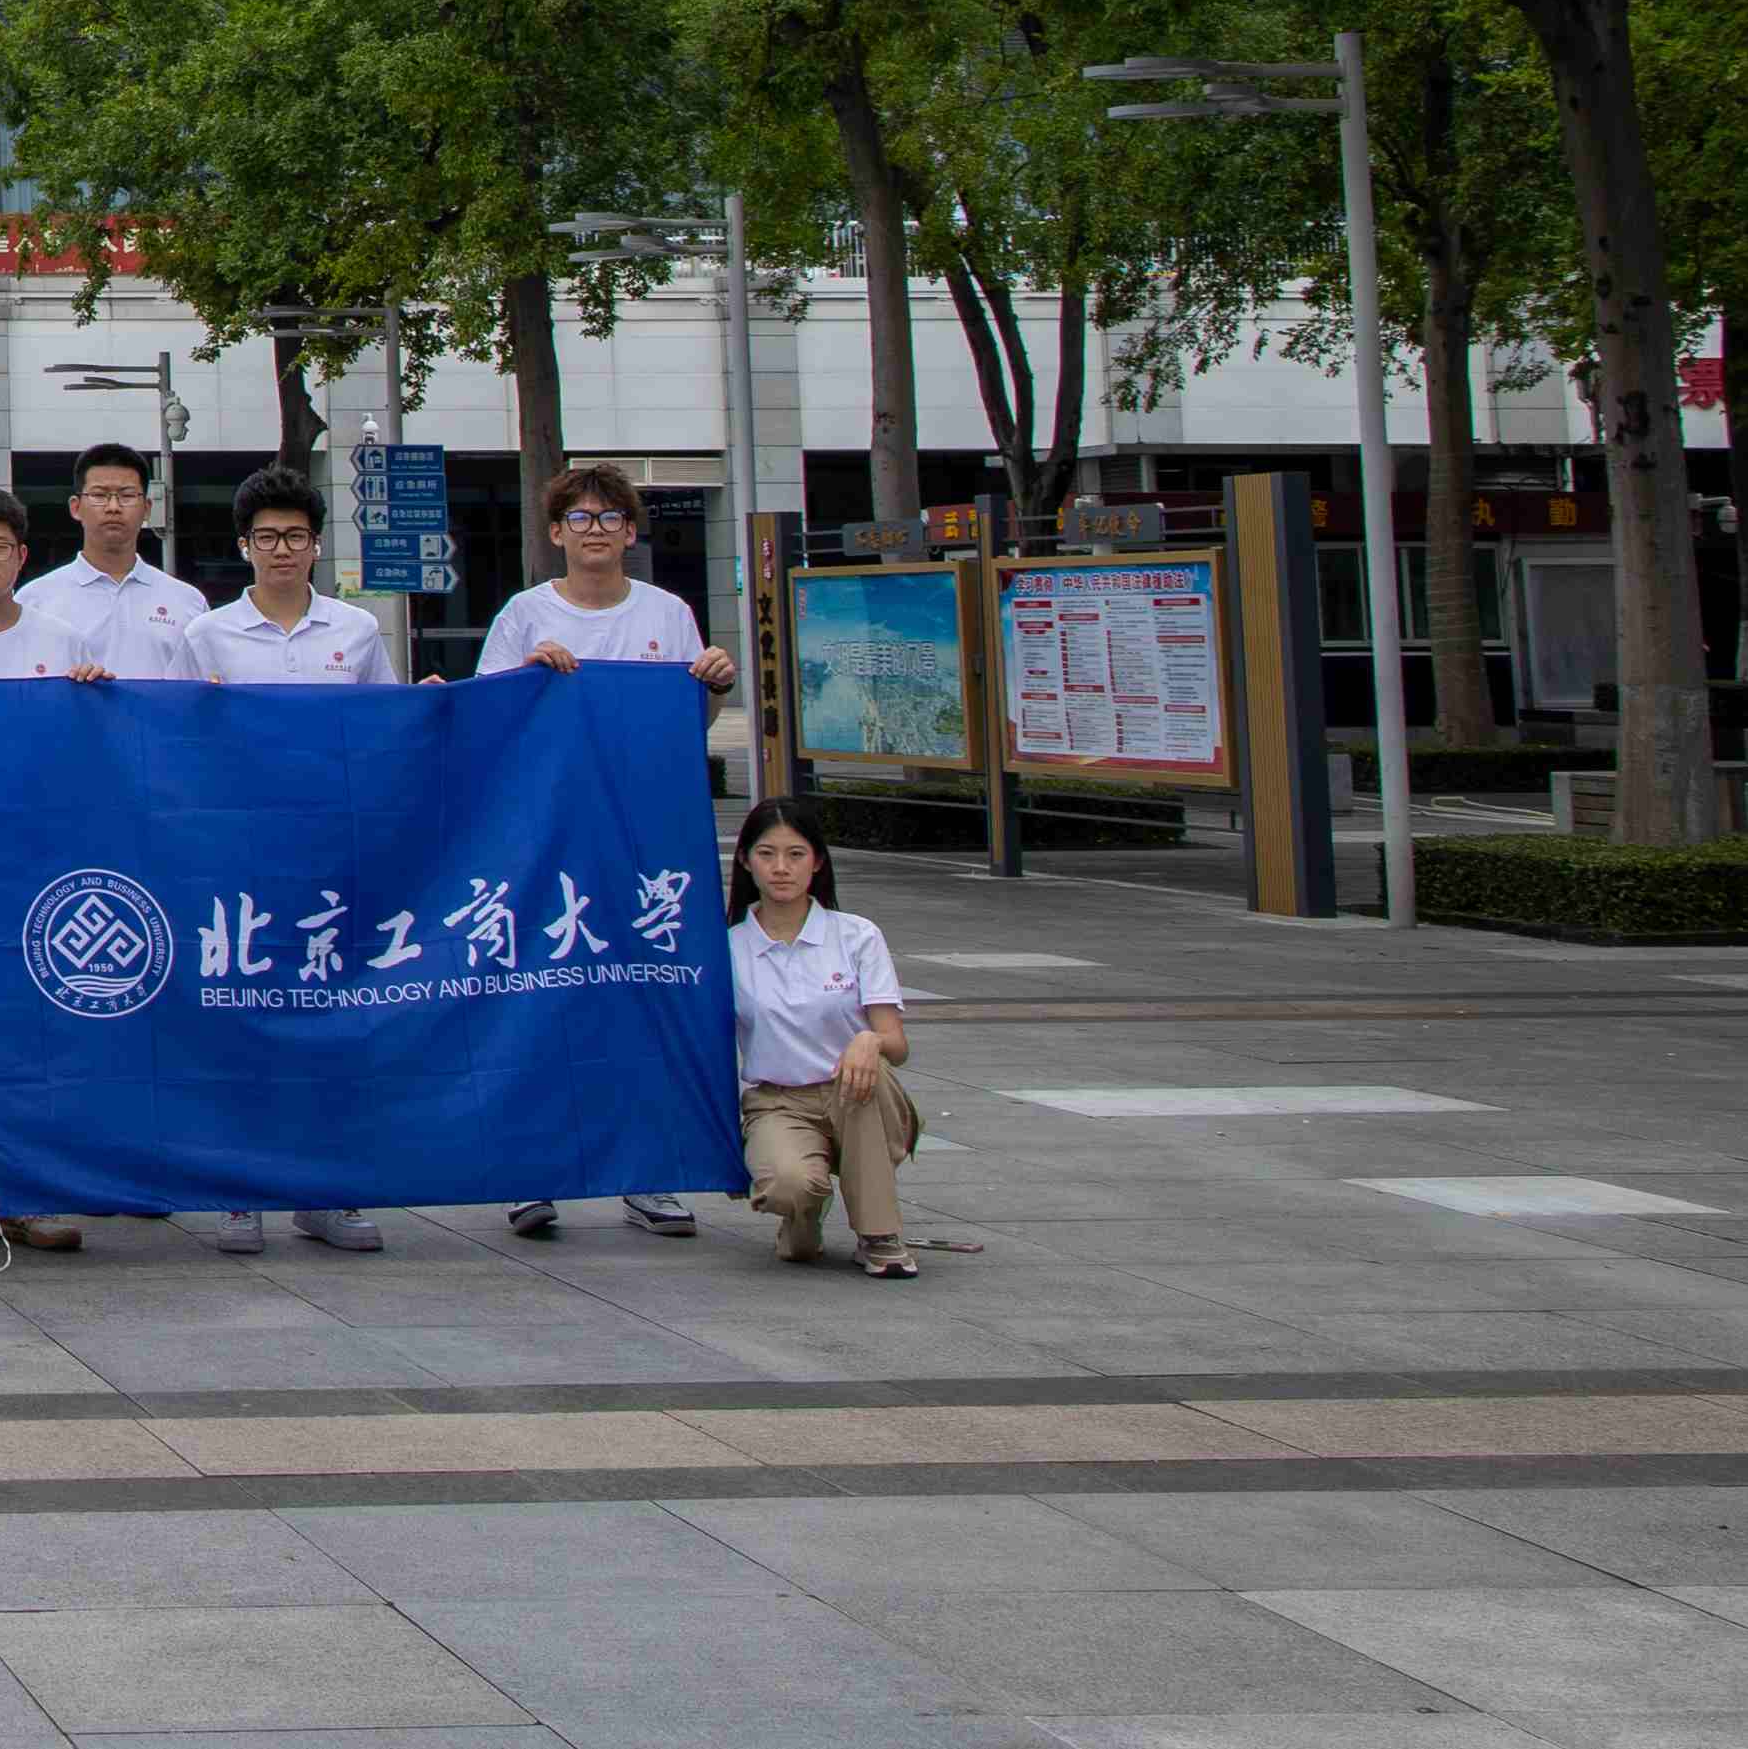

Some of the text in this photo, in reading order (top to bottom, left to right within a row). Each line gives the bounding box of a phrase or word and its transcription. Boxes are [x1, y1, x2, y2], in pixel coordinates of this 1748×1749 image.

[31, 881, 78, 936] TECHNOLOGY
[80, 876, 104, 888] AND
[106, 878, 153, 915] BUSINESS
[148, 915, 167, 978] UNIVERSITY
[197, 867, 693, 983] 北京工商大学
[88, 962, 115, 974] 1950
[200, 961, 703, 1009] BEIJING TECHNOLOGY AND BUSINESS UNIVERSITY
